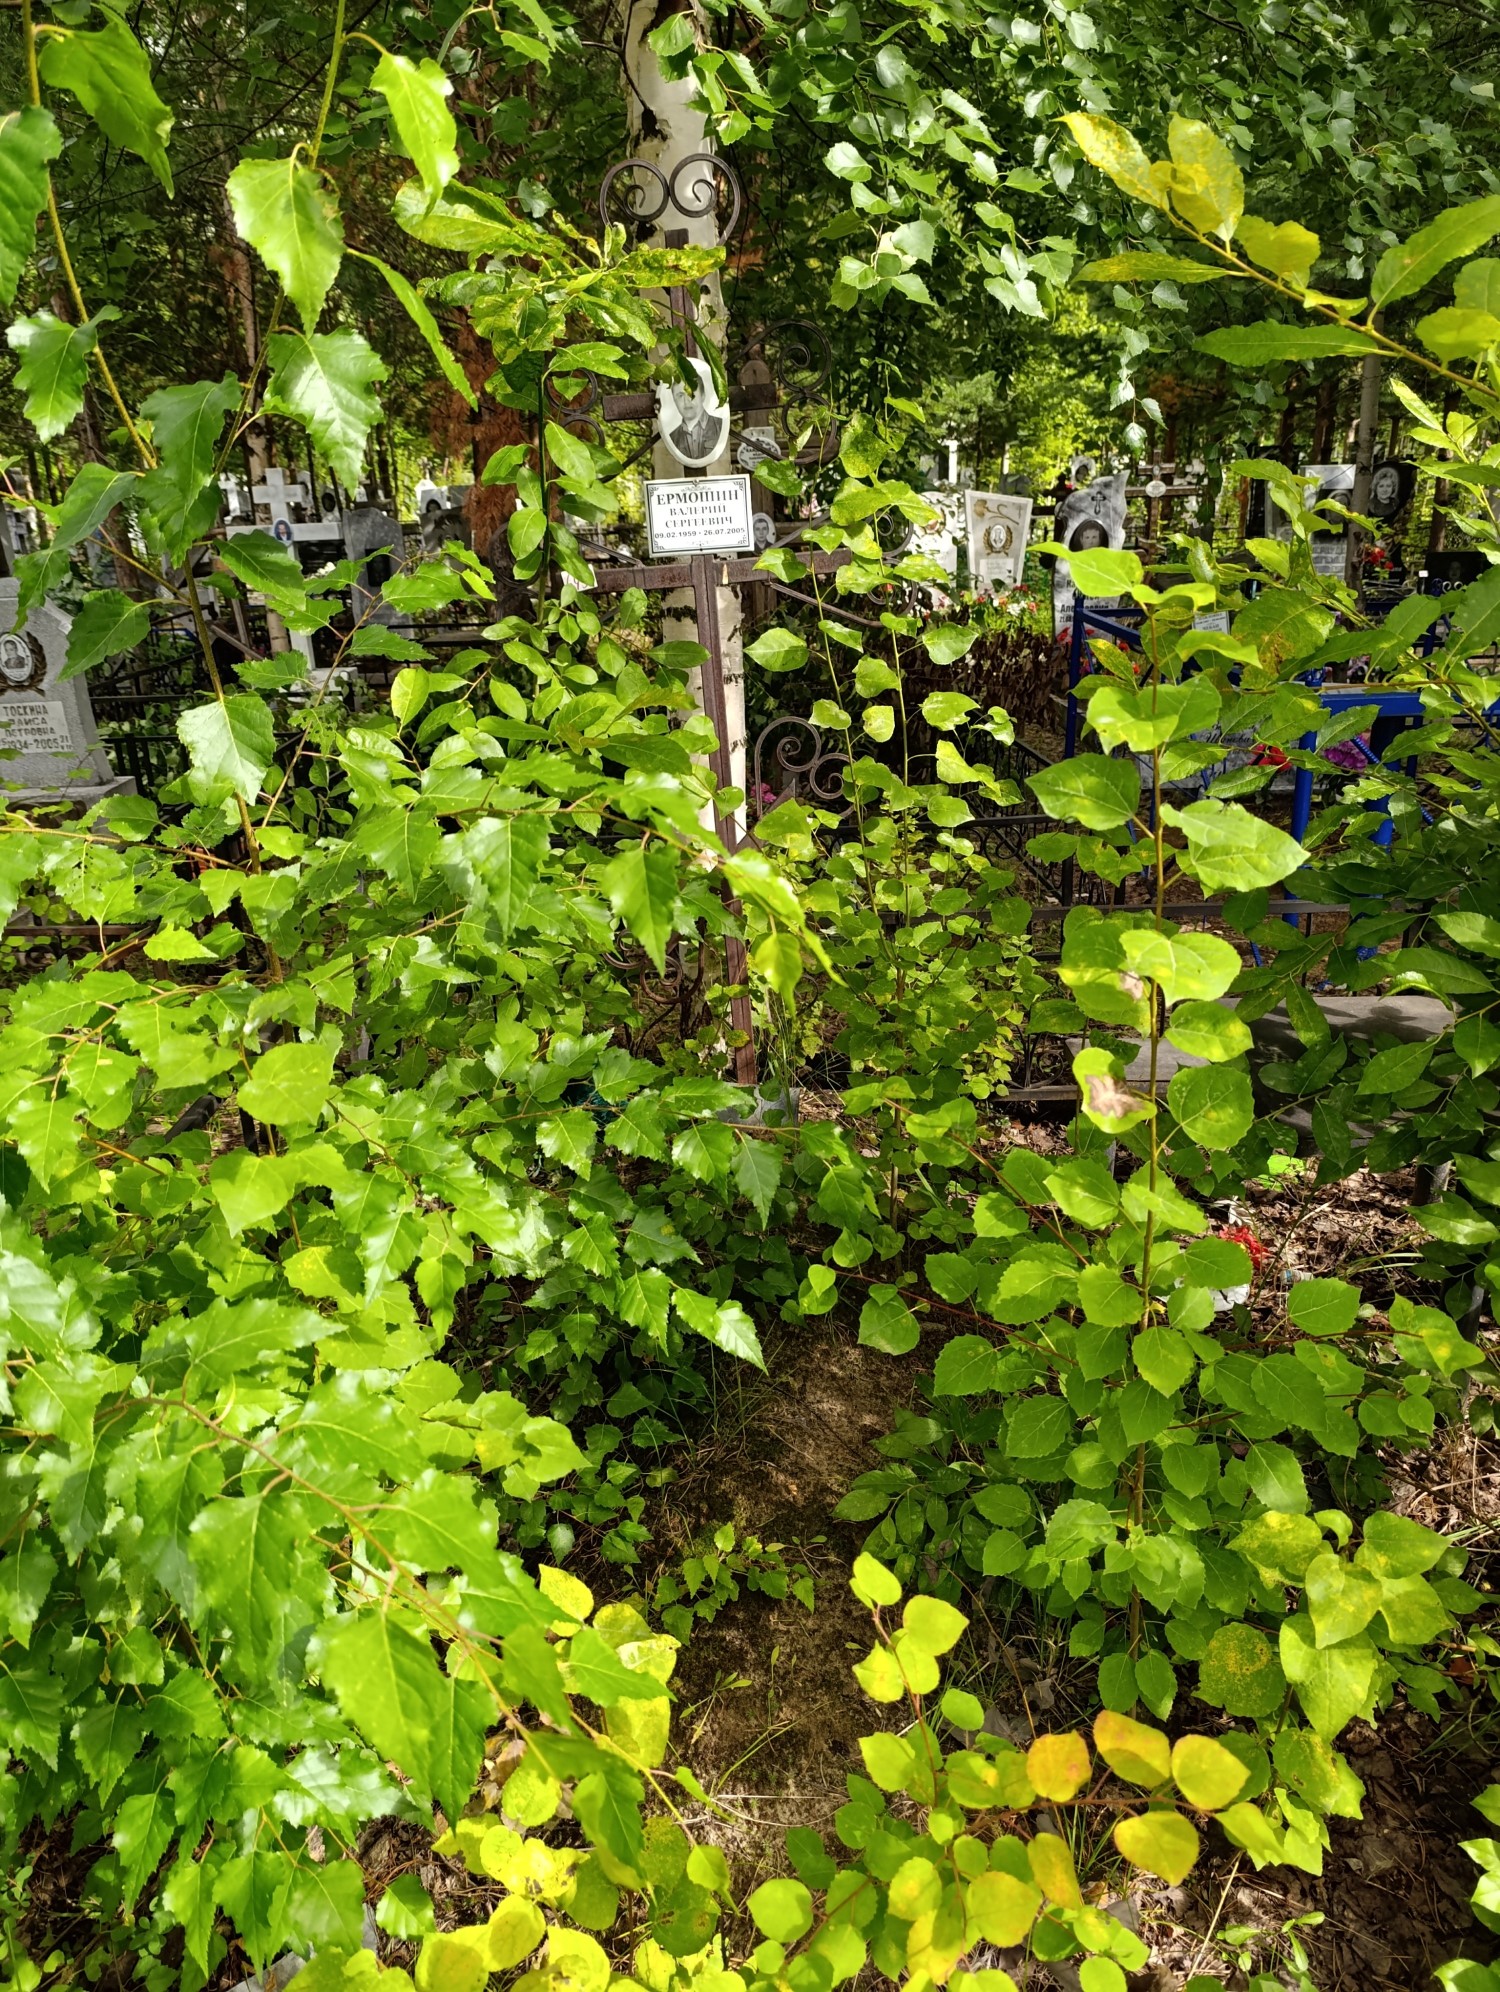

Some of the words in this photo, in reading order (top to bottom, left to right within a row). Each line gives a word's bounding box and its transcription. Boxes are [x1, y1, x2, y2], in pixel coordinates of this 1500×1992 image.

[657, 489, 738, 505] ЕРМОШИН
[670, 503, 726, 516] ВАЛЕРИЙ
[665, 516, 732, 528] СЕРГЕЕВИЧ
[654, 530, 697, 539] 09.02.1959
[703, 527, 745, 535] 26.07.2005
[2, 705, 48, 716] ТОСКИНА
[5, 727, 56, 737] ПЕТРОВНА
